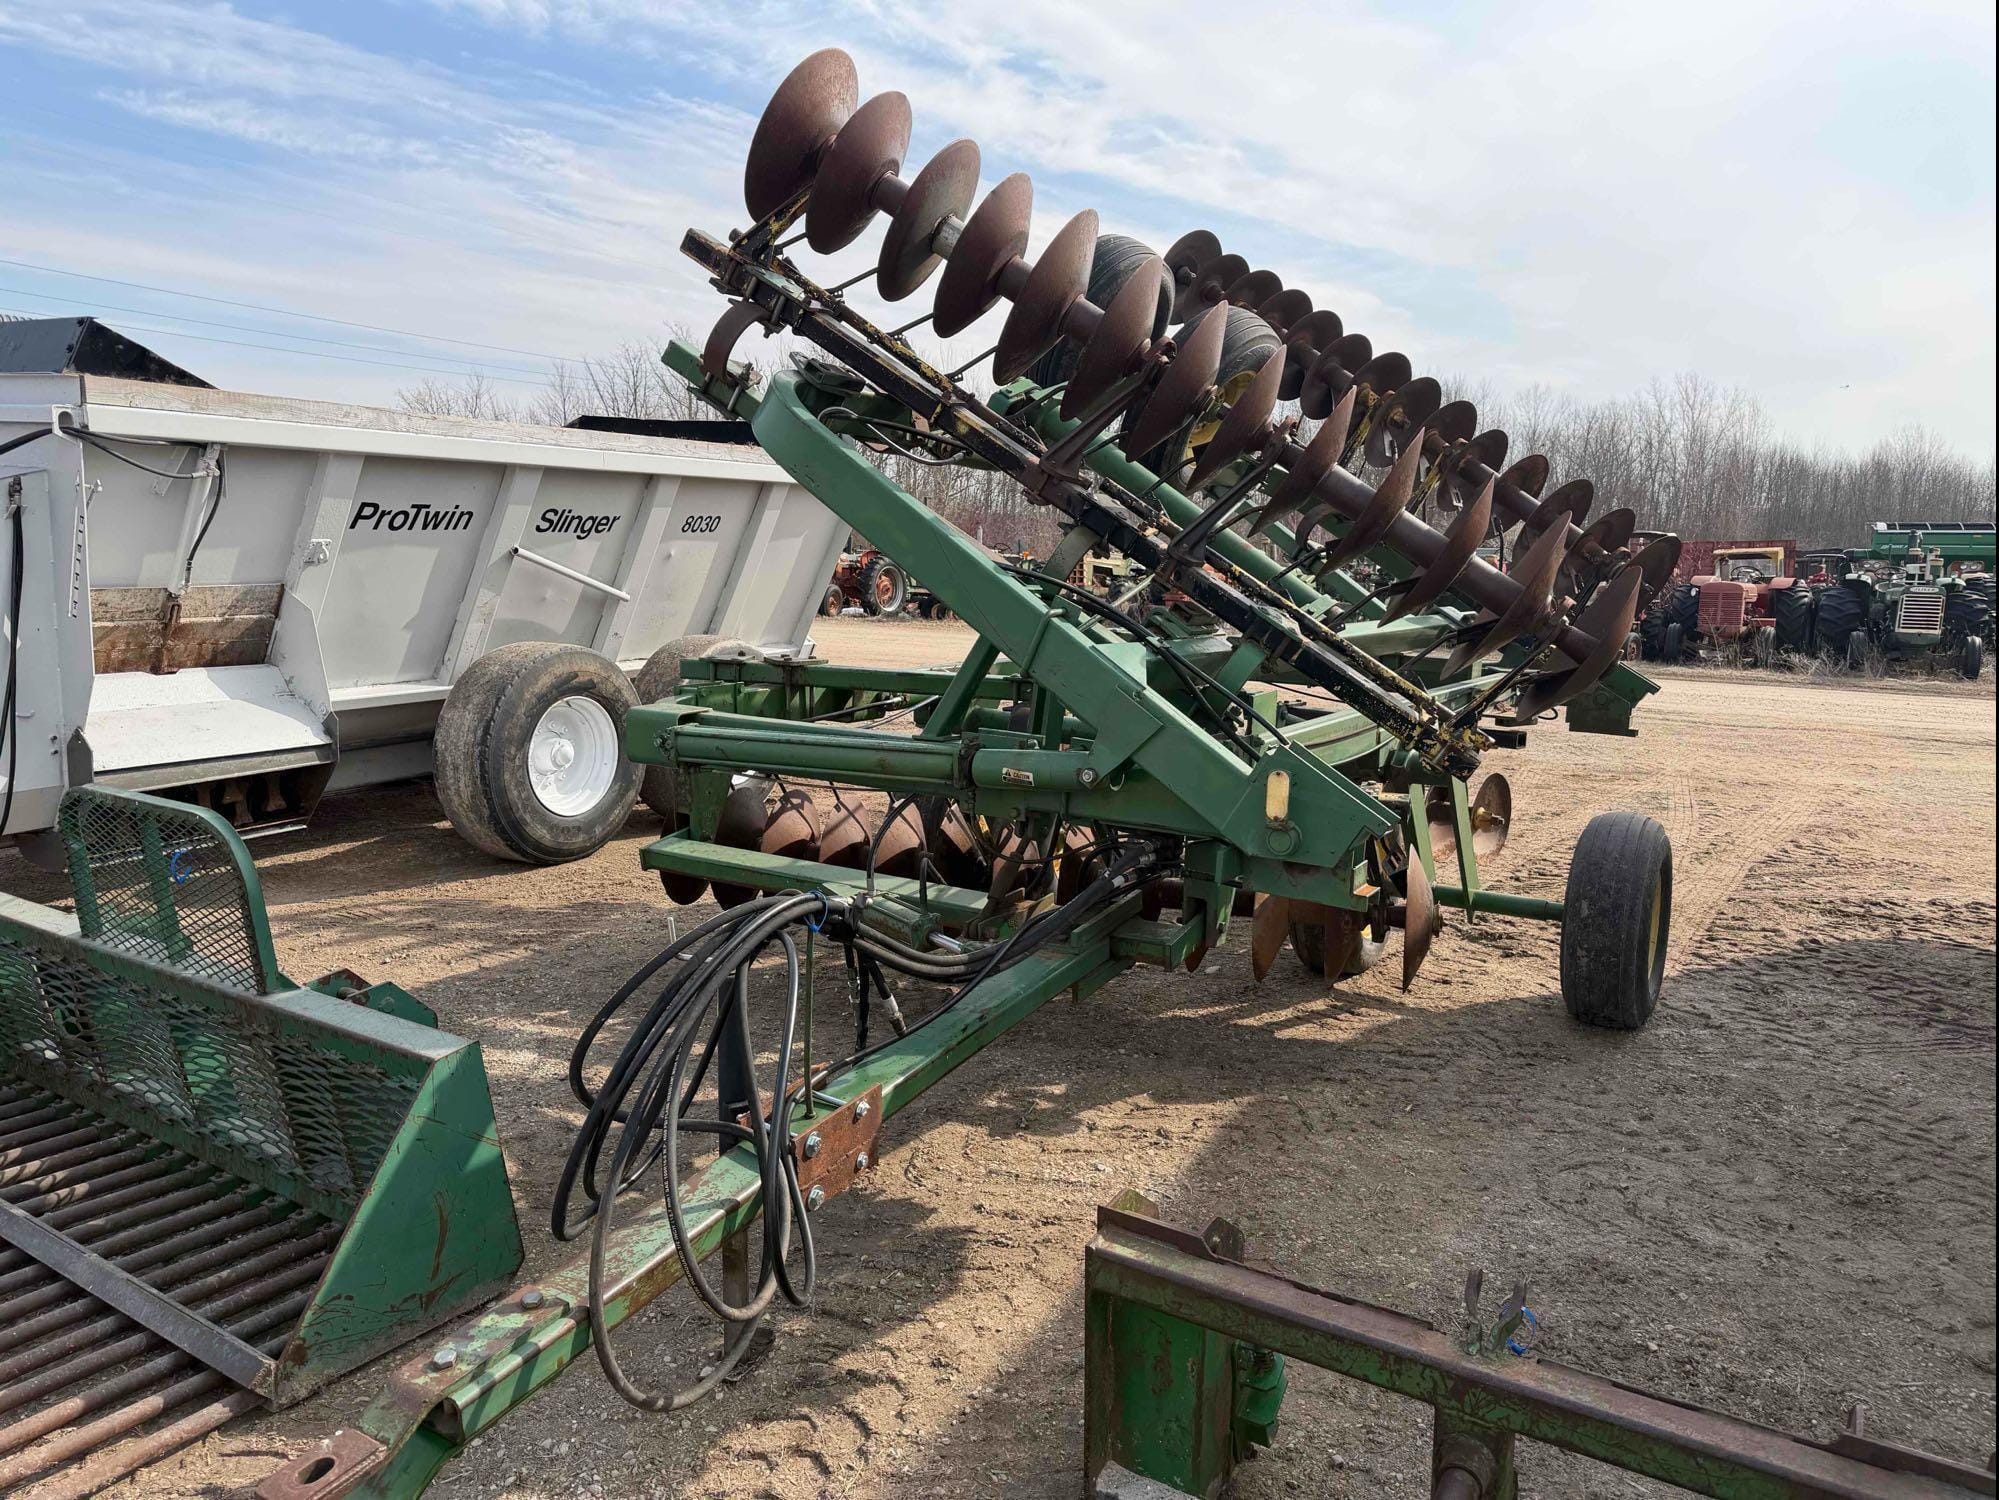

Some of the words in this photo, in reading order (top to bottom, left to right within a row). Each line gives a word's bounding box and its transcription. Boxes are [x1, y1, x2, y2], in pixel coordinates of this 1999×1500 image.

[349, 502, 473, 531] ProTwin
[535, 509, 621, 540] Slinger
[682, 516, 721, 533] 8030
